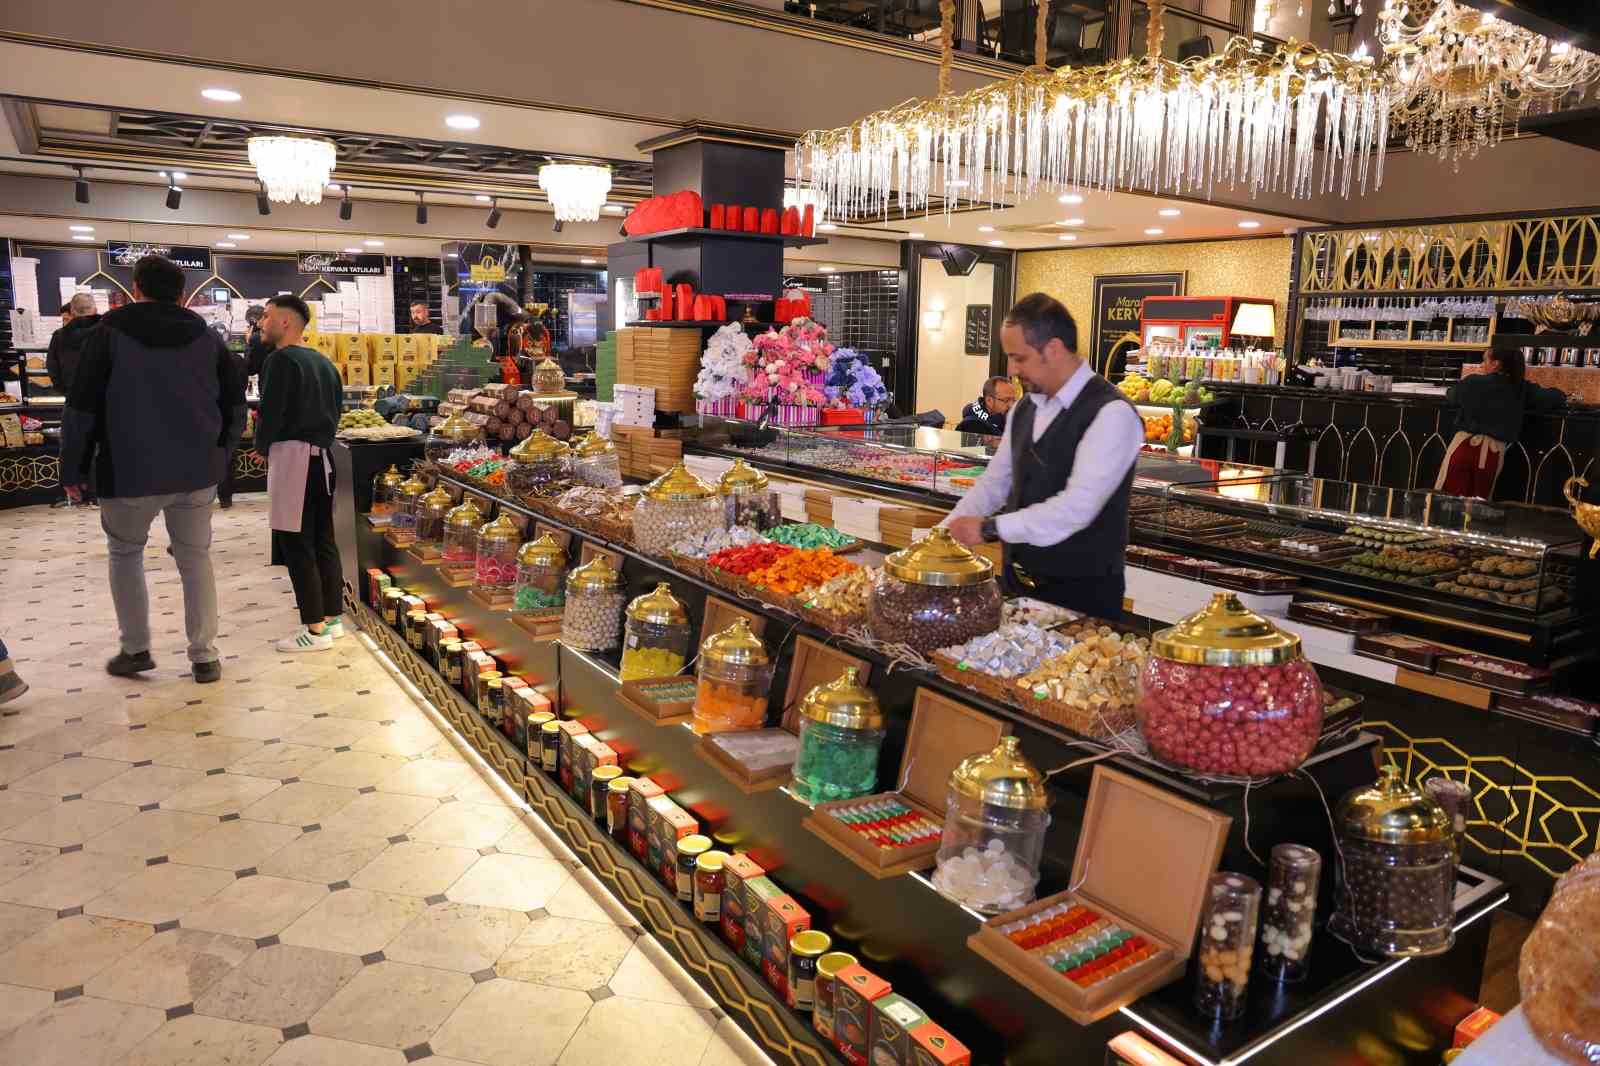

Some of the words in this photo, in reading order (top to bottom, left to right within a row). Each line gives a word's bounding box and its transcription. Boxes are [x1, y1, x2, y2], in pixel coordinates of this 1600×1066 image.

[172, 258, 204, 266] TLILARI
[1116, 296, 1142, 307] Mara
[1107, 307, 1141, 320] KERV
[972, 404, 989, 420] EAR
